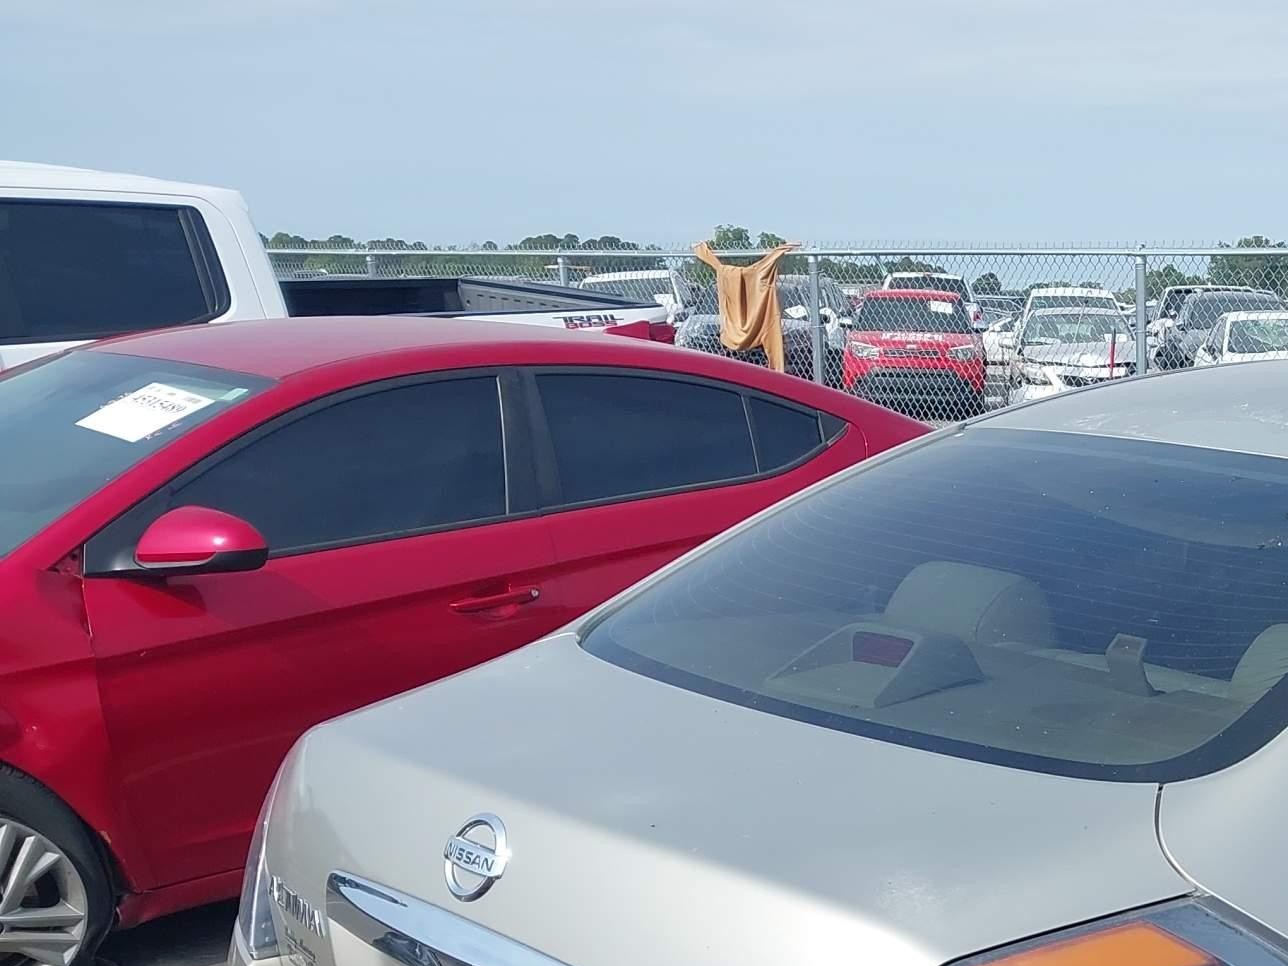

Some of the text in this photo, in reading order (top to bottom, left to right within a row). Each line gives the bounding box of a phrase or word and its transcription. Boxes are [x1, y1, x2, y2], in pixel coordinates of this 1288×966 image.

[553, 313, 625, 324] TRAIL
[566, 321, 618, 329] BOSS
[446, 842, 496, 873] NISSAN
